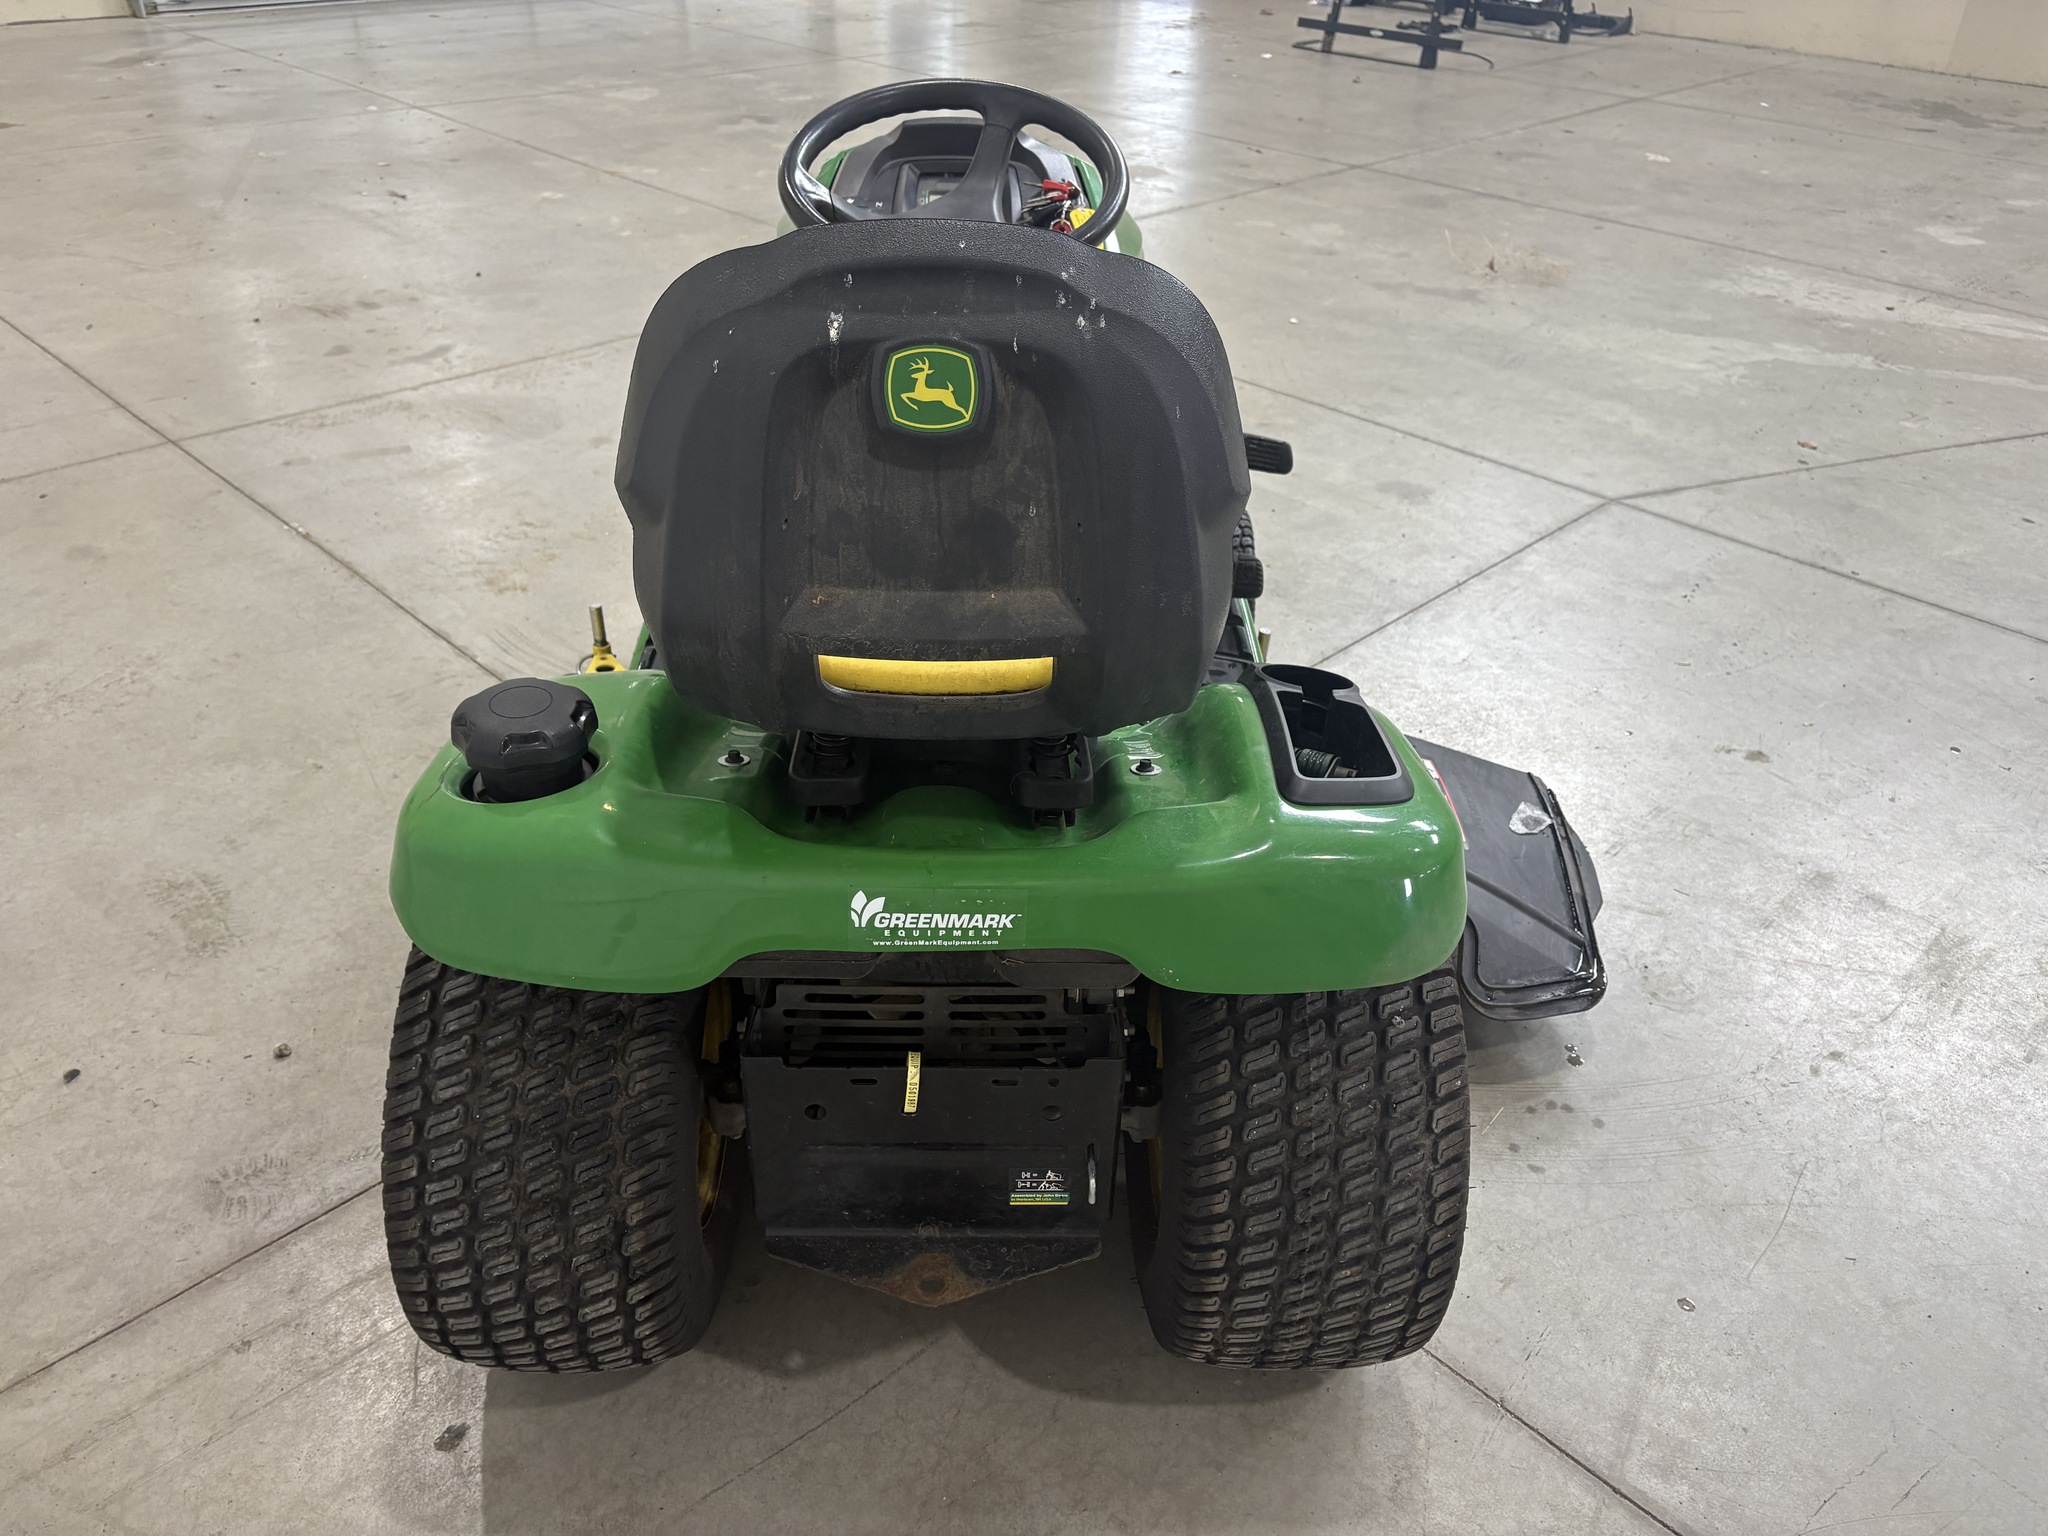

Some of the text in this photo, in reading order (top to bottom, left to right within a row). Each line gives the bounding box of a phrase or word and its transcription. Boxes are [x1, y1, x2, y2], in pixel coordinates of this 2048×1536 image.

[874, 913, 1016, 928] GREENMARK
[884, 929, 1003, 937] EQUIPMENT
[872, 939, 999, 947] www.GreenMarkEquipment.com
